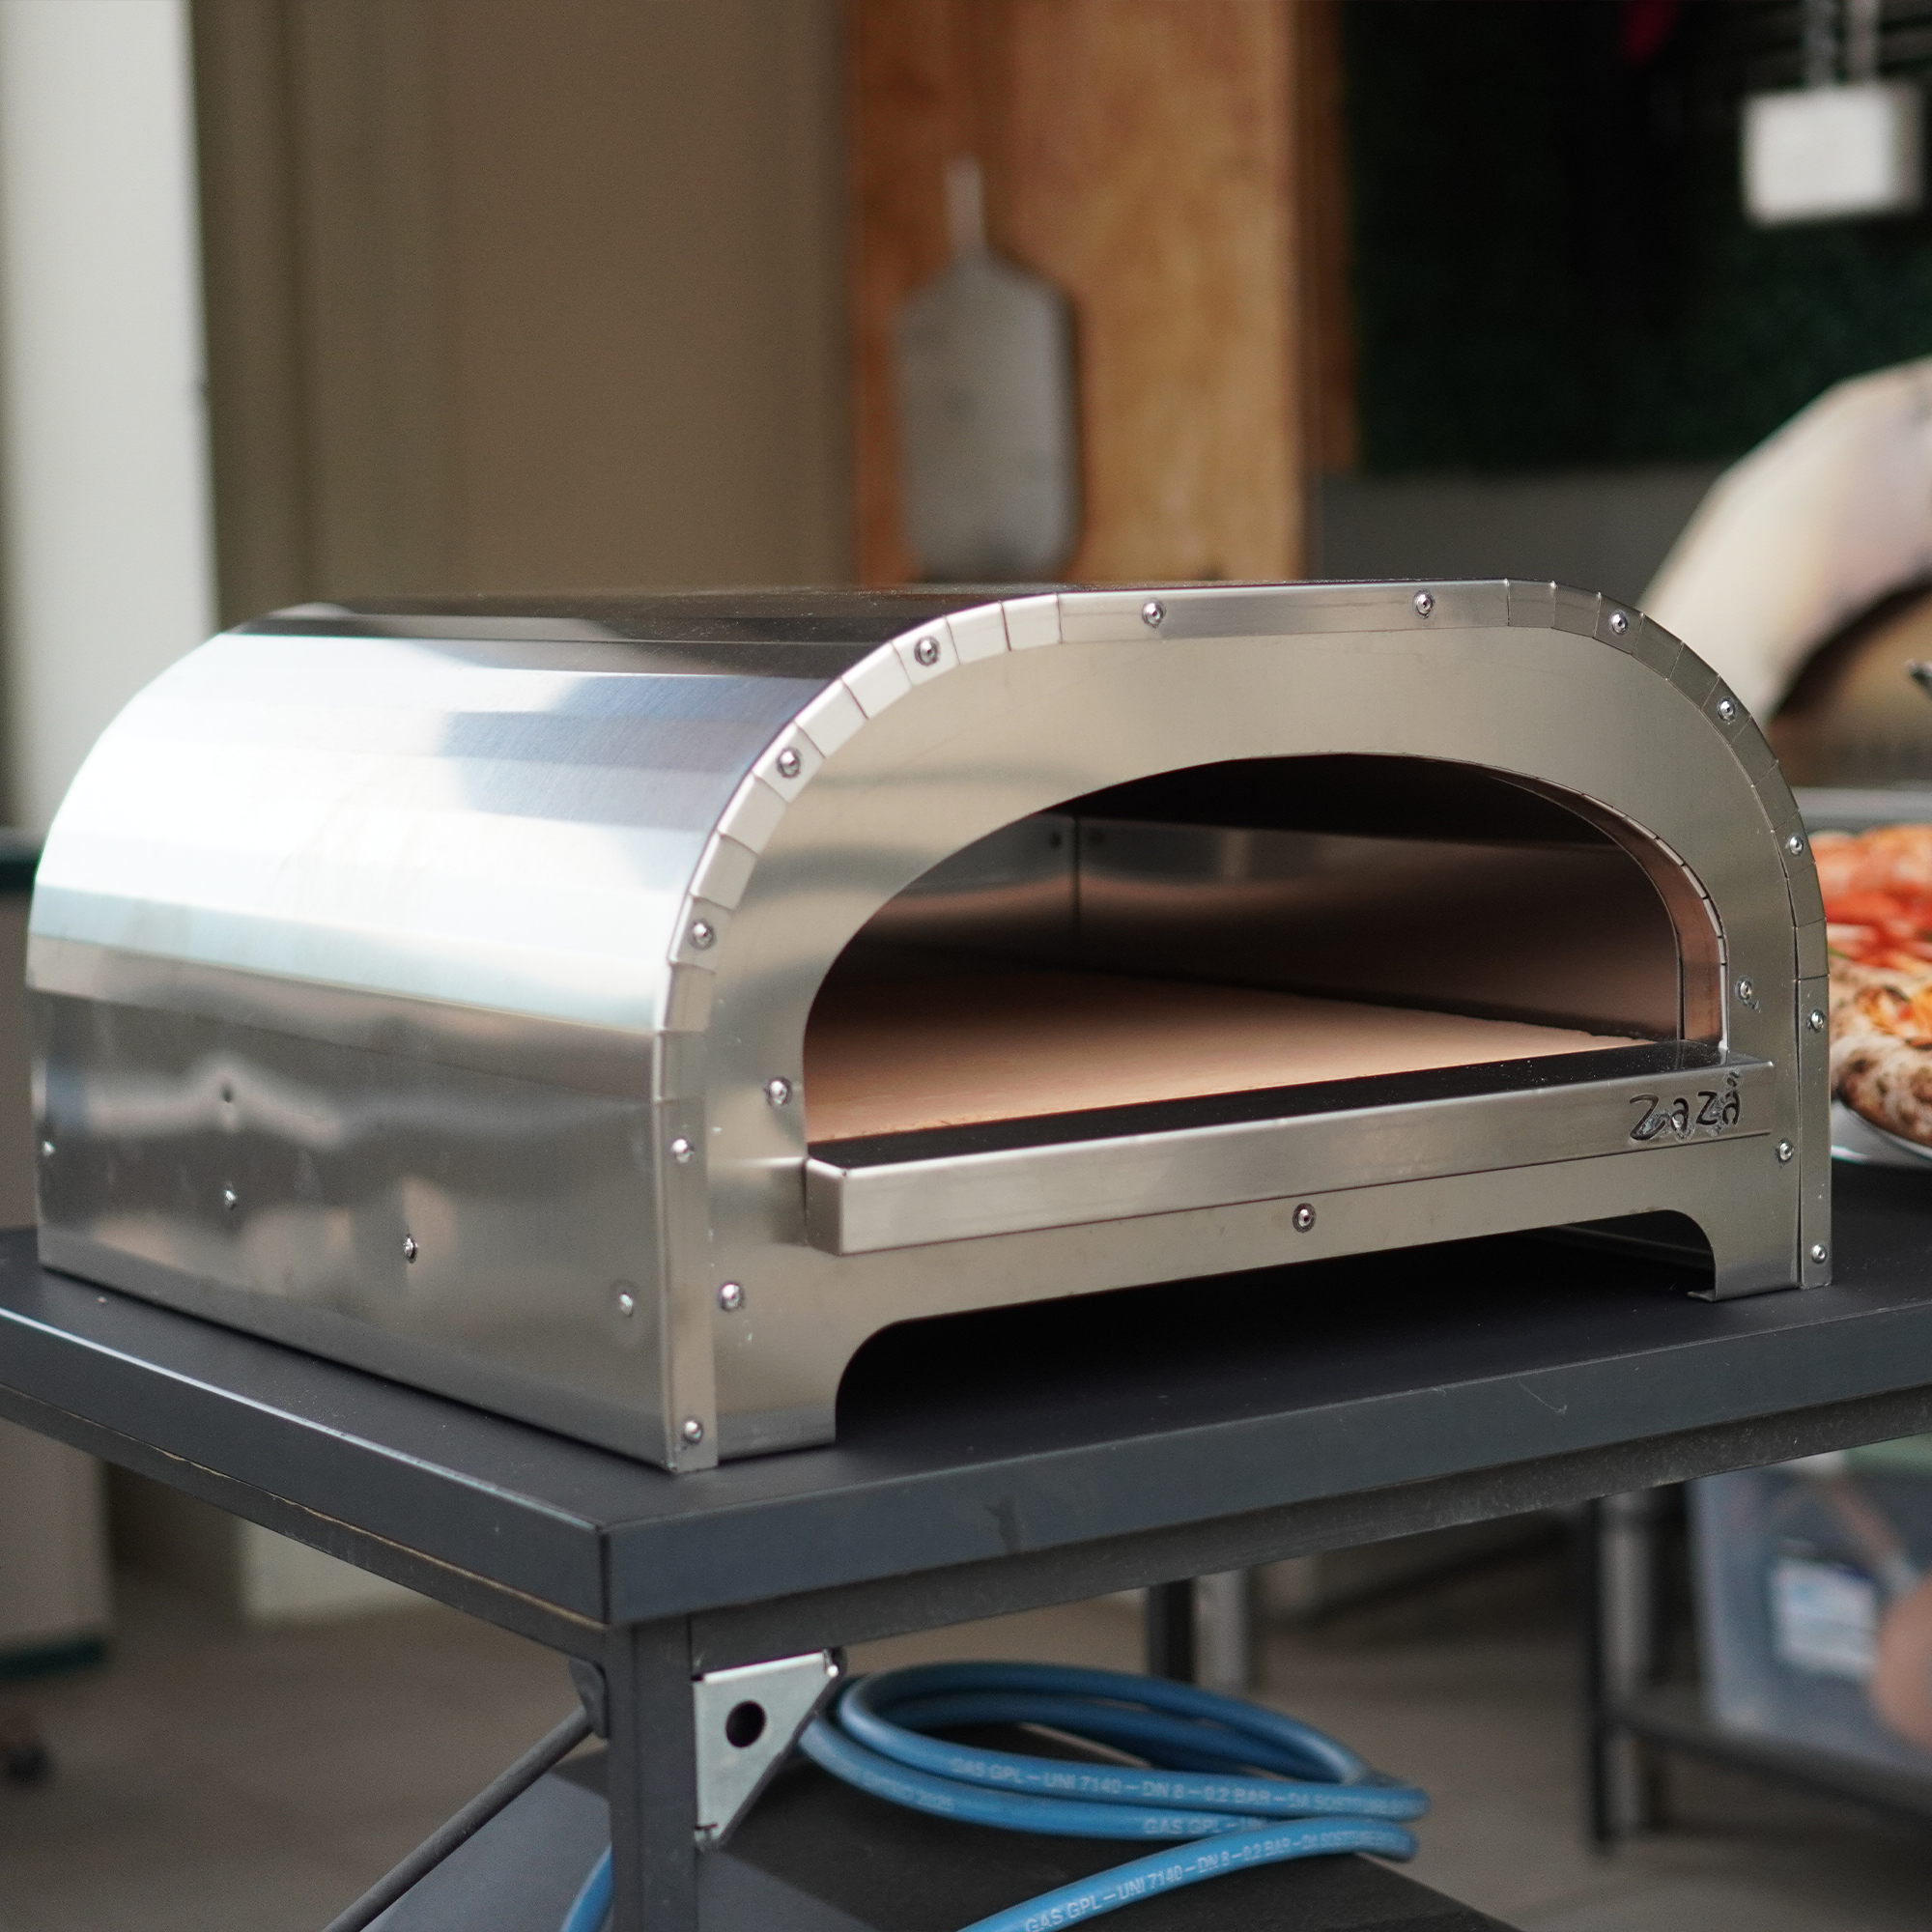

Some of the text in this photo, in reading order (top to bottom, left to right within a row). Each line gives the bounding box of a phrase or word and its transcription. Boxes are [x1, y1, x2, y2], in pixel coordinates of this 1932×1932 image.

[951, 1757, 985, 1777] GAS
[988, 1764, 1021, 1784] GPL
[1043, 1772, 1075, 1789] UNI
[1080, 1776, 1122, 1794] 7140
[1142, 1780, 1170, 1798] DN
[1144, 1817, 1184, 1834] GAS
[1188, 1817, 1222, 1833] GPL
[1025, 1909, 1065, 1932] GAS
[1067, 1895, 1103, 1918] GPL
[1118, 1878, 1147, 1900] UNI
[1148, 1864, 1183, 1889] 7140
[1197, 1853, 1219, 1874] DN
